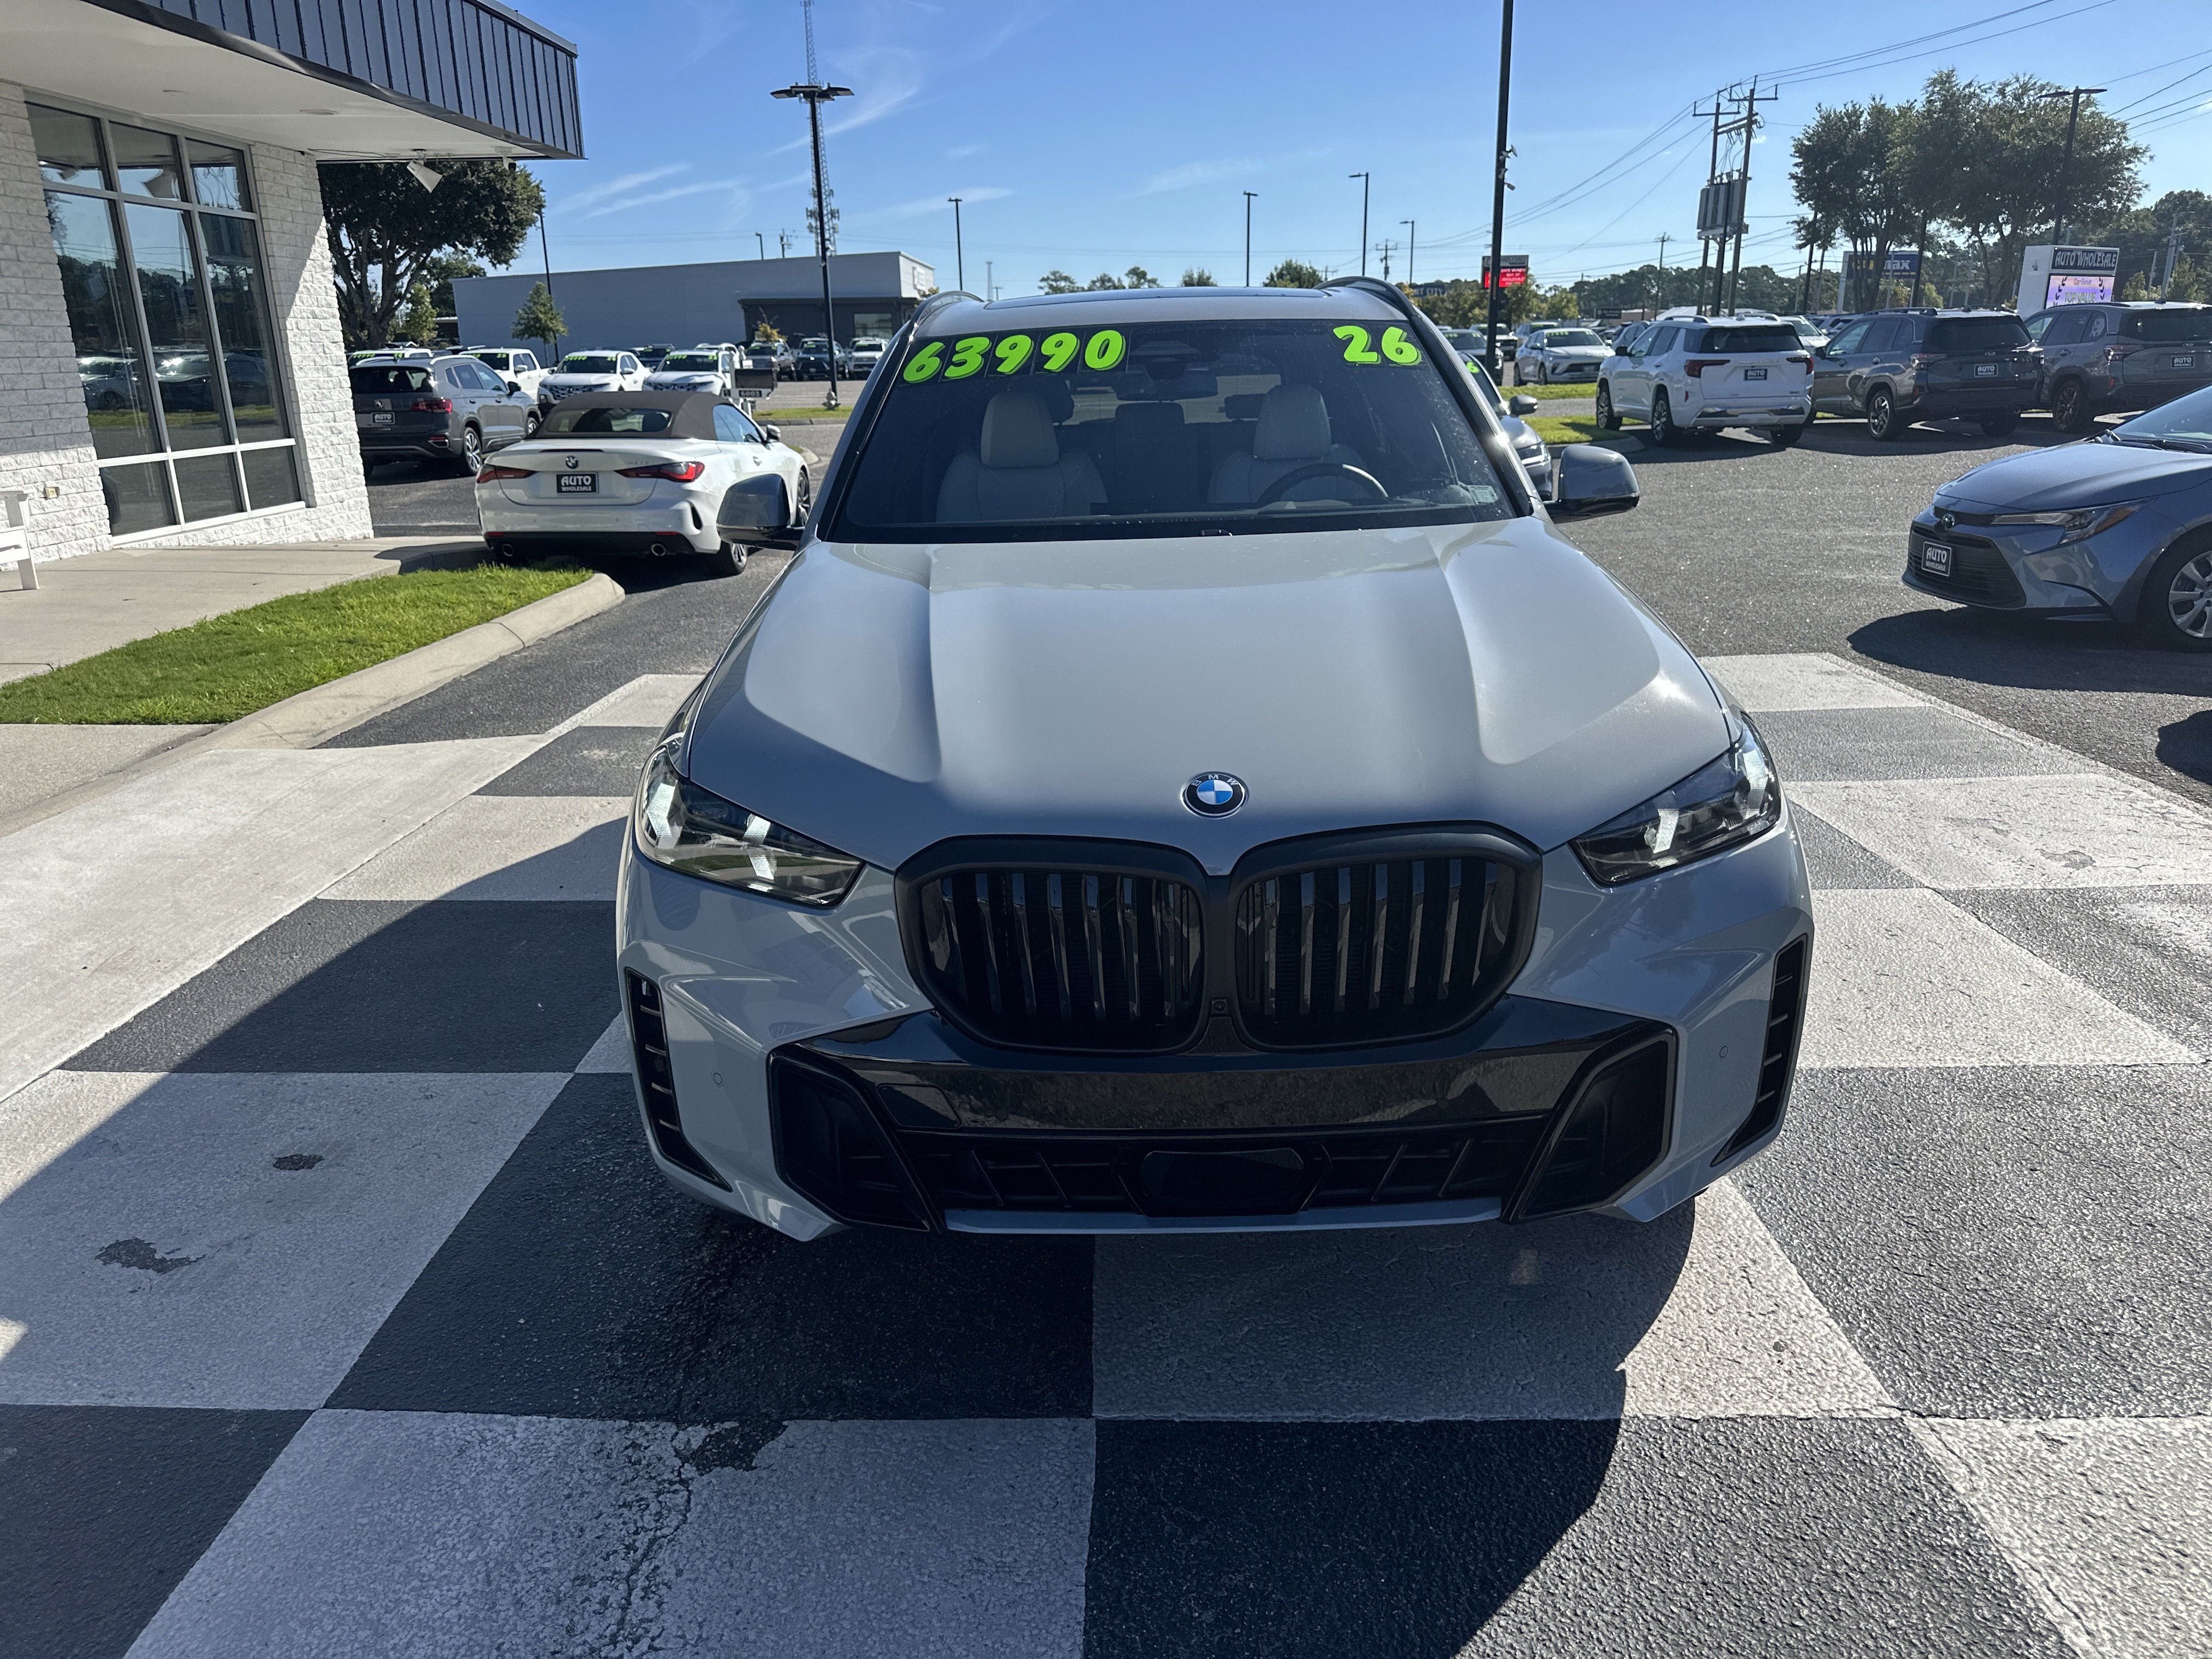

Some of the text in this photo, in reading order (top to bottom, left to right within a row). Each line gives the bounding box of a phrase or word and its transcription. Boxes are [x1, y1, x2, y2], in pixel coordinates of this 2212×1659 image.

[2055, 251, 2117, 268] AUTO WHOLESALE
[902, 325, 1422, 383] 63990 26
[561, 475, 592, 486] AUTO
[1926, 547, 1947, 563] AUTO
[1191, 774, 1239, 787] BMW
